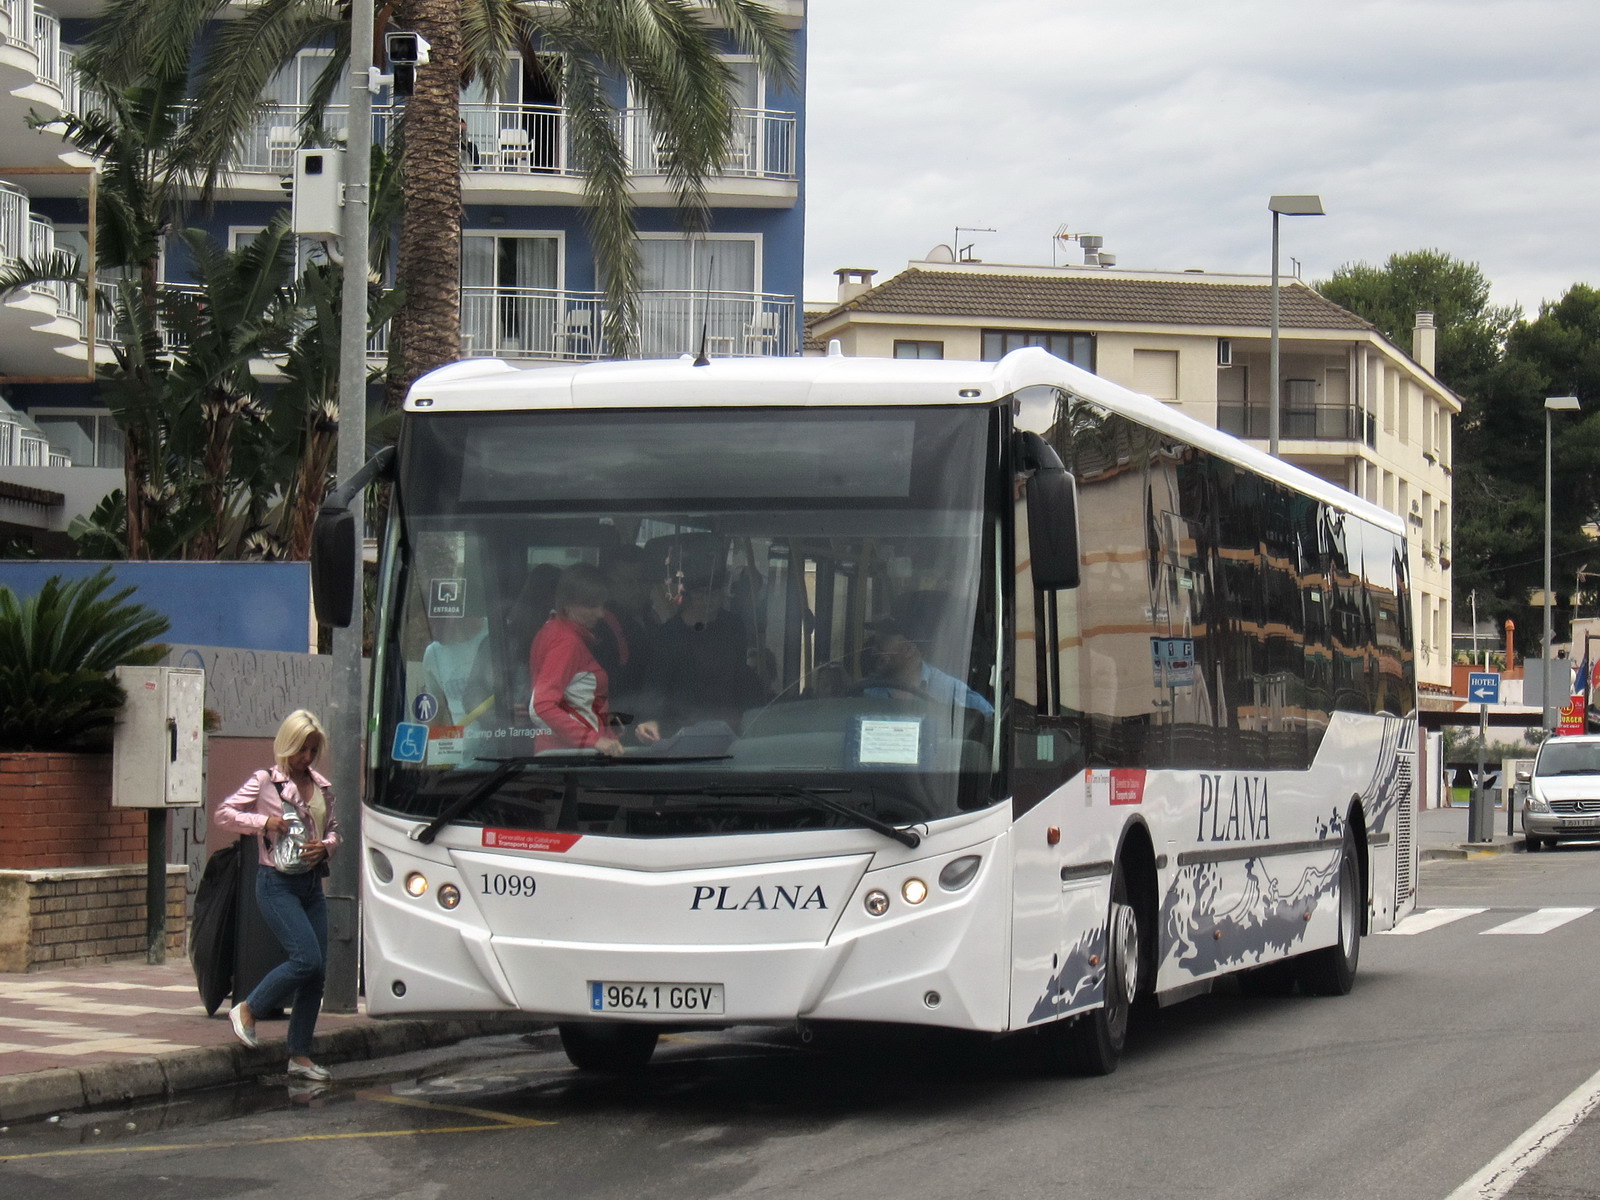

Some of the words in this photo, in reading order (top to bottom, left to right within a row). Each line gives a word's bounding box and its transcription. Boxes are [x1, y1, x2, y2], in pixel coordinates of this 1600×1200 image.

[1471, 678, 1497, 687] HOTEL
[494, 728, 506, 738] de
[508, 727, 552, 738] Tarragona
[1196, 774, 1270, 842] PLANA
[498, 840, 528, 848] Transports
[481, 873, 537, 898] 1099
[689, 884, 829, 911] PLANA
[607, 986, 661, 1009] 9641
[670, 987, 712, 1010] GGV
